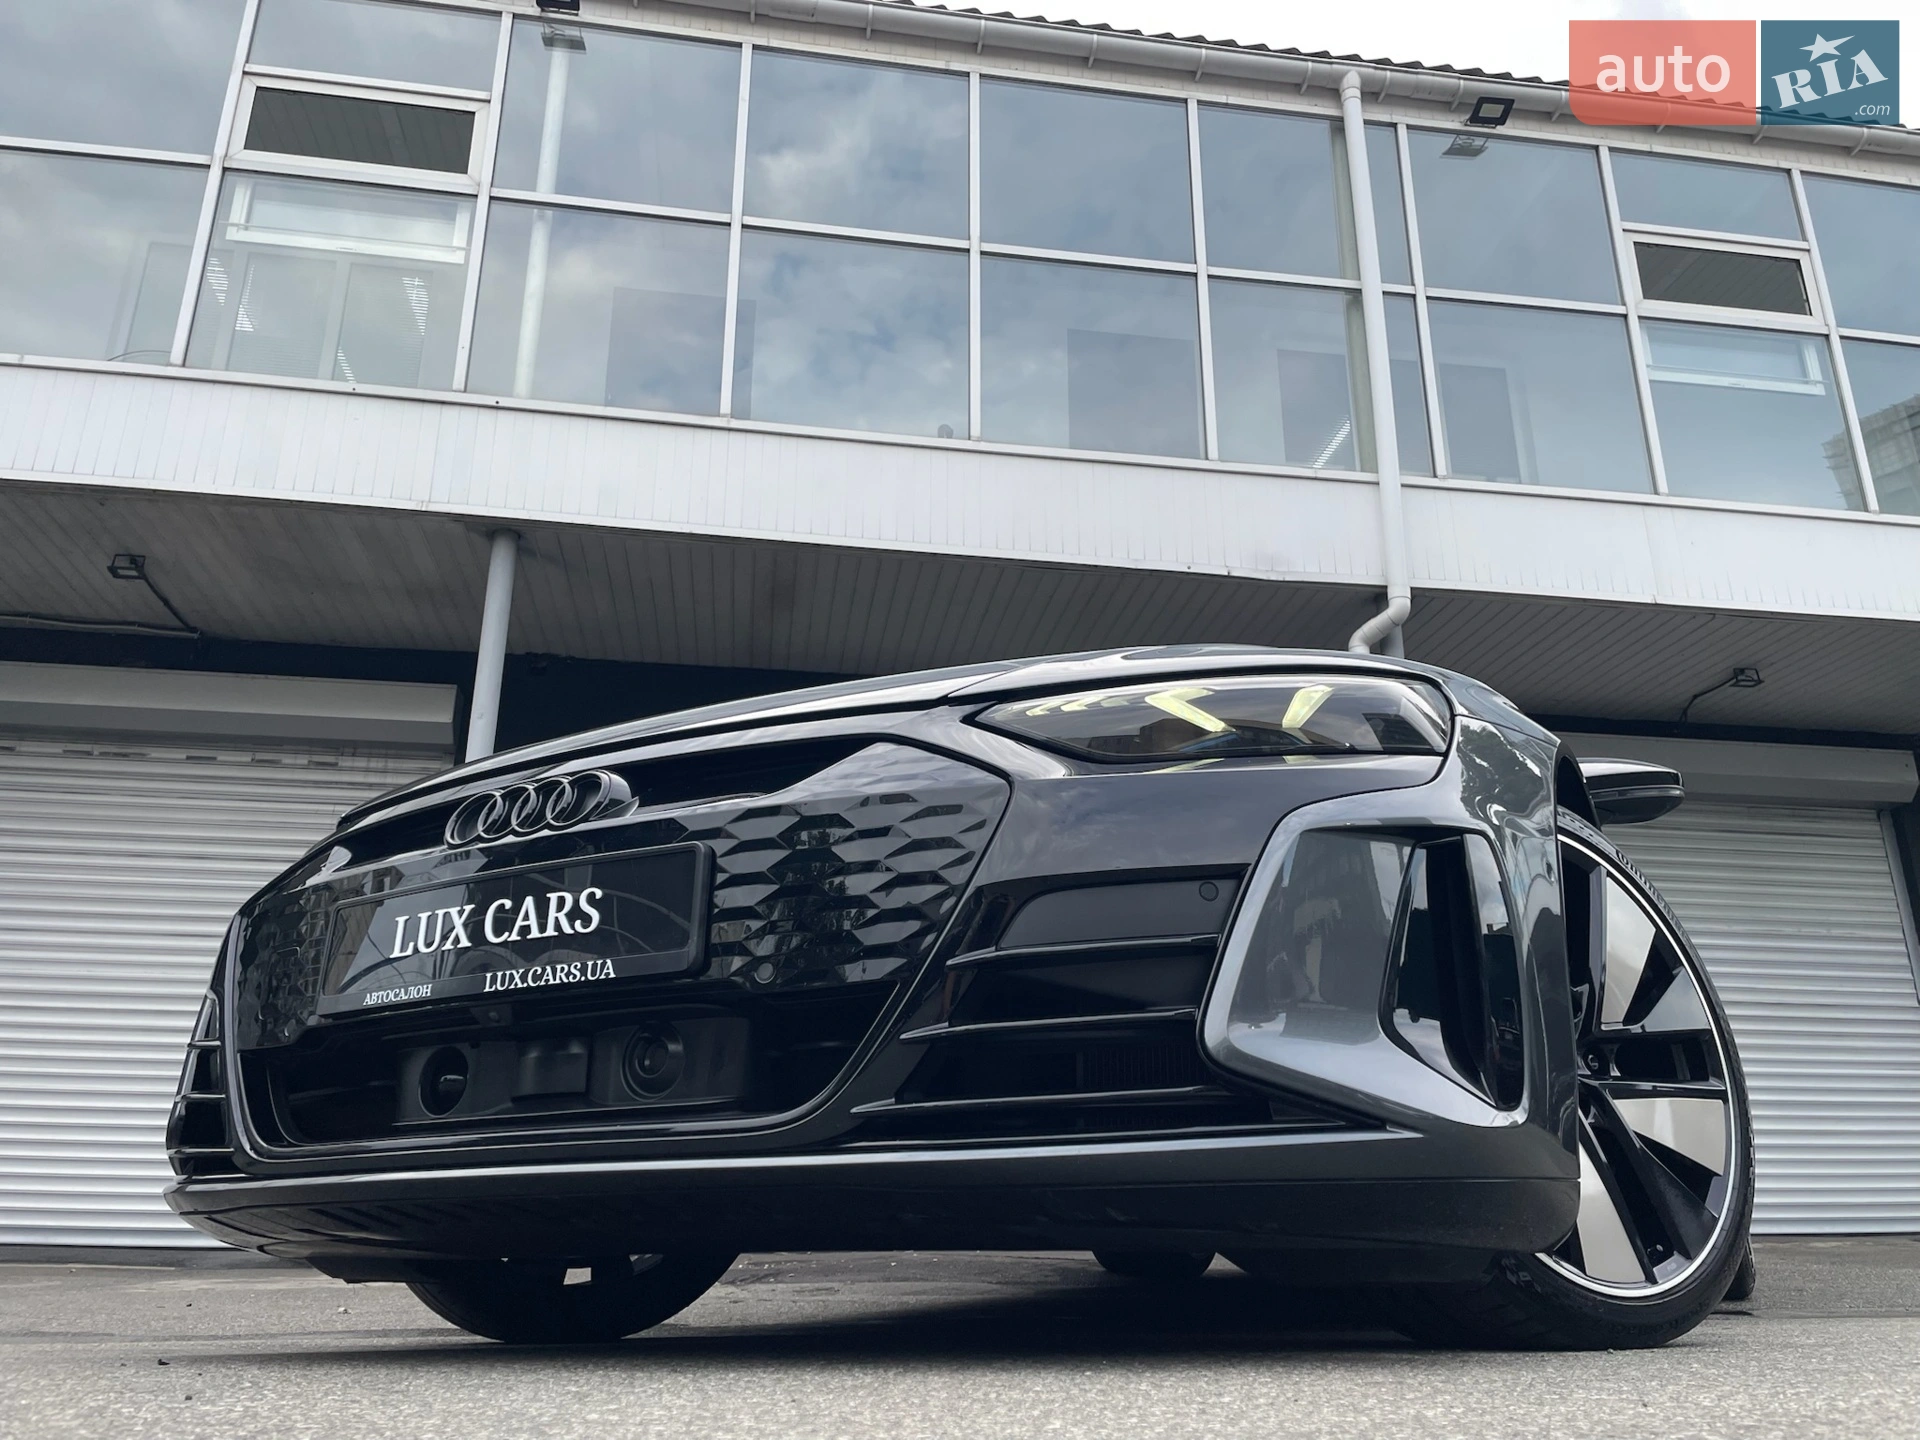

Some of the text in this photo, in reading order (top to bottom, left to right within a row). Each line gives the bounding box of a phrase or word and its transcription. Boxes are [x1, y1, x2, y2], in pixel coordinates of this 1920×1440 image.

[389, 887, 603, 959] LUX CARS
[483, 959, 616, 992] LUX.CARS.UA
[363, 984, 432, 1006] АВТОСАЛОН
